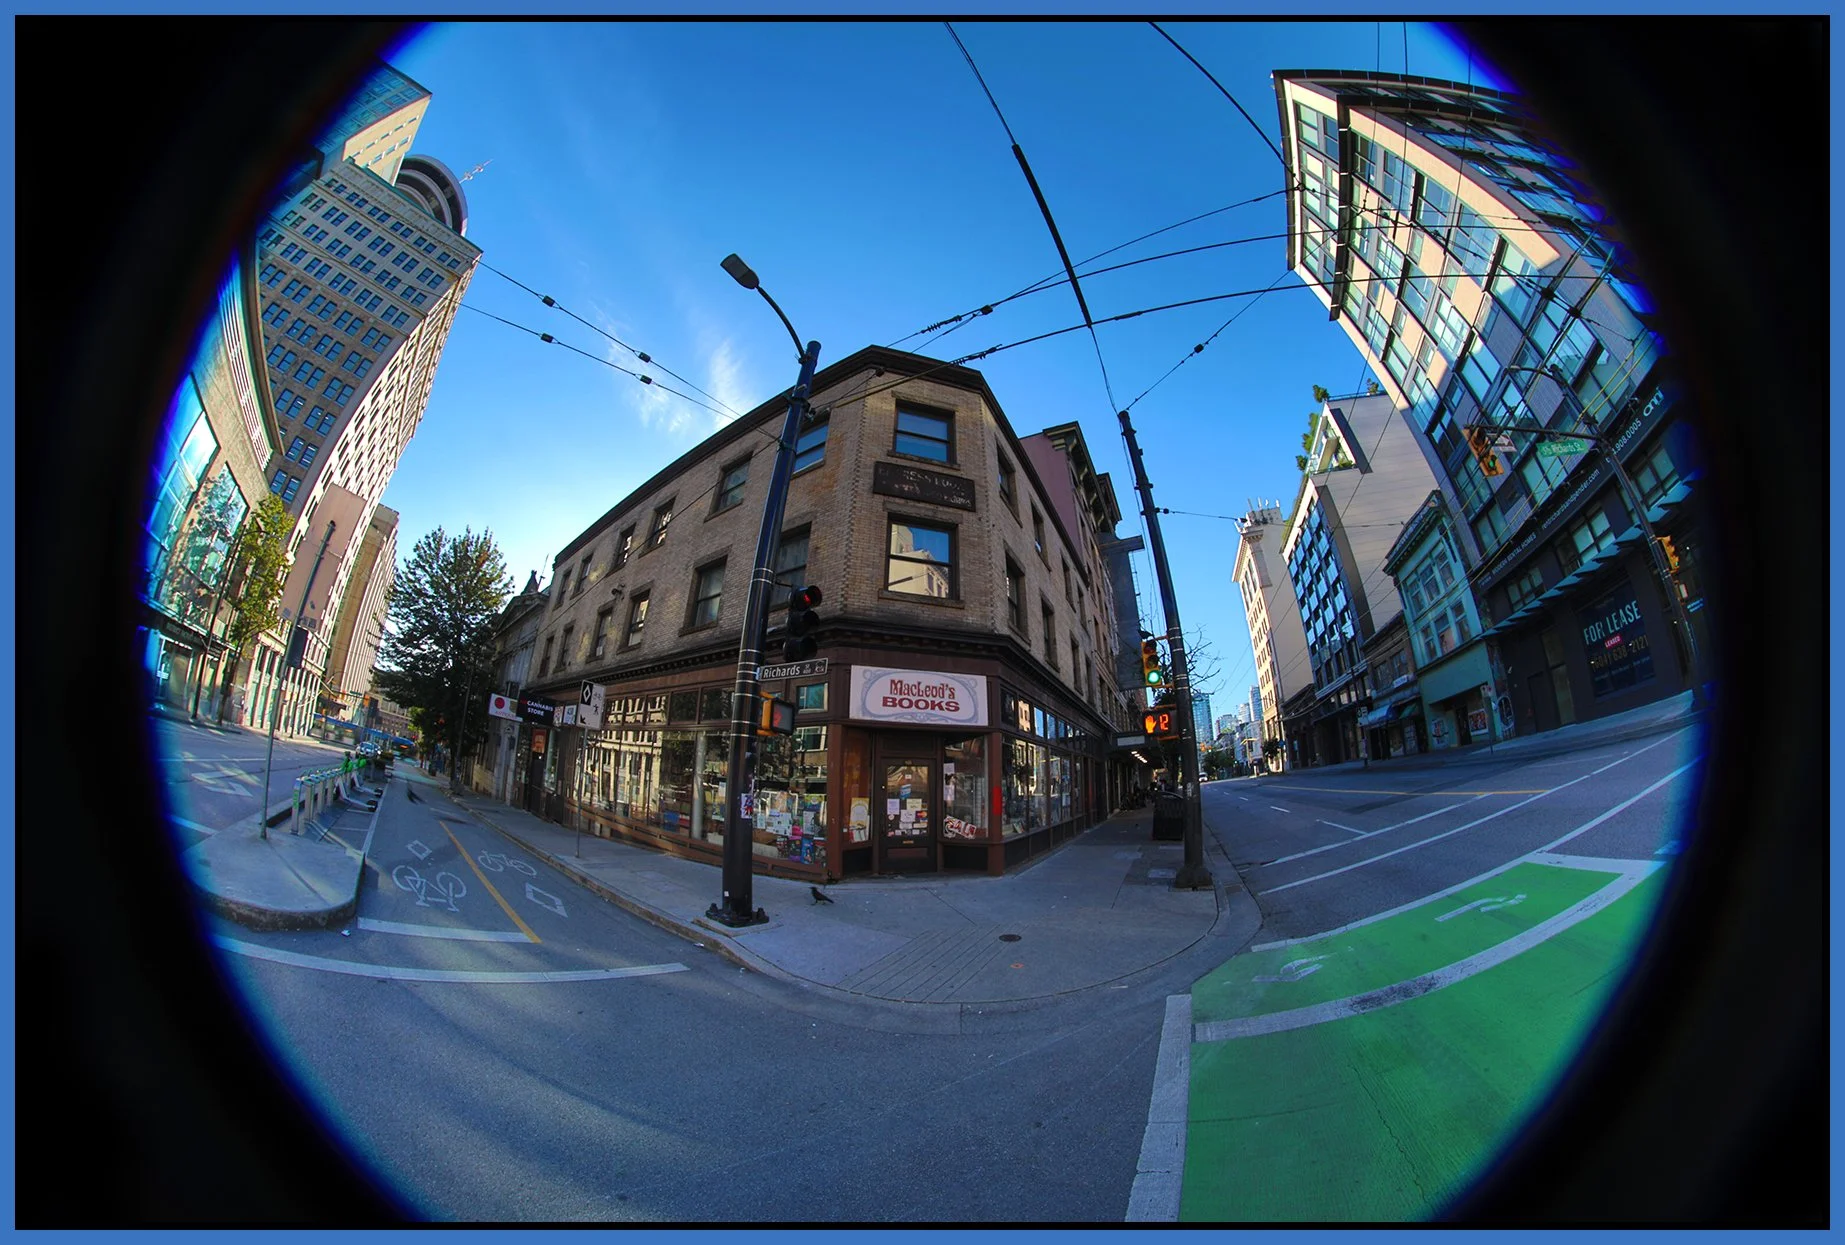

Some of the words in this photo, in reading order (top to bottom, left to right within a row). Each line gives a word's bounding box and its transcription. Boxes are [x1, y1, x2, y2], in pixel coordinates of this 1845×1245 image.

[1521, 532, 1537, 549] HOMES
[1583, 621, 1605, 645] FOR
[1606, 600, 1641, 634] LEASE
[763, 665, 800, 678] Richards
[890, 679, 955, 699] MacLeod's
[527, 700, 553, 712] CANNABIS
[527, 707, 544, 716] STORE
[882, 696, 960, 712] BOOKS
[1160, 713, 1169, 731] 12
